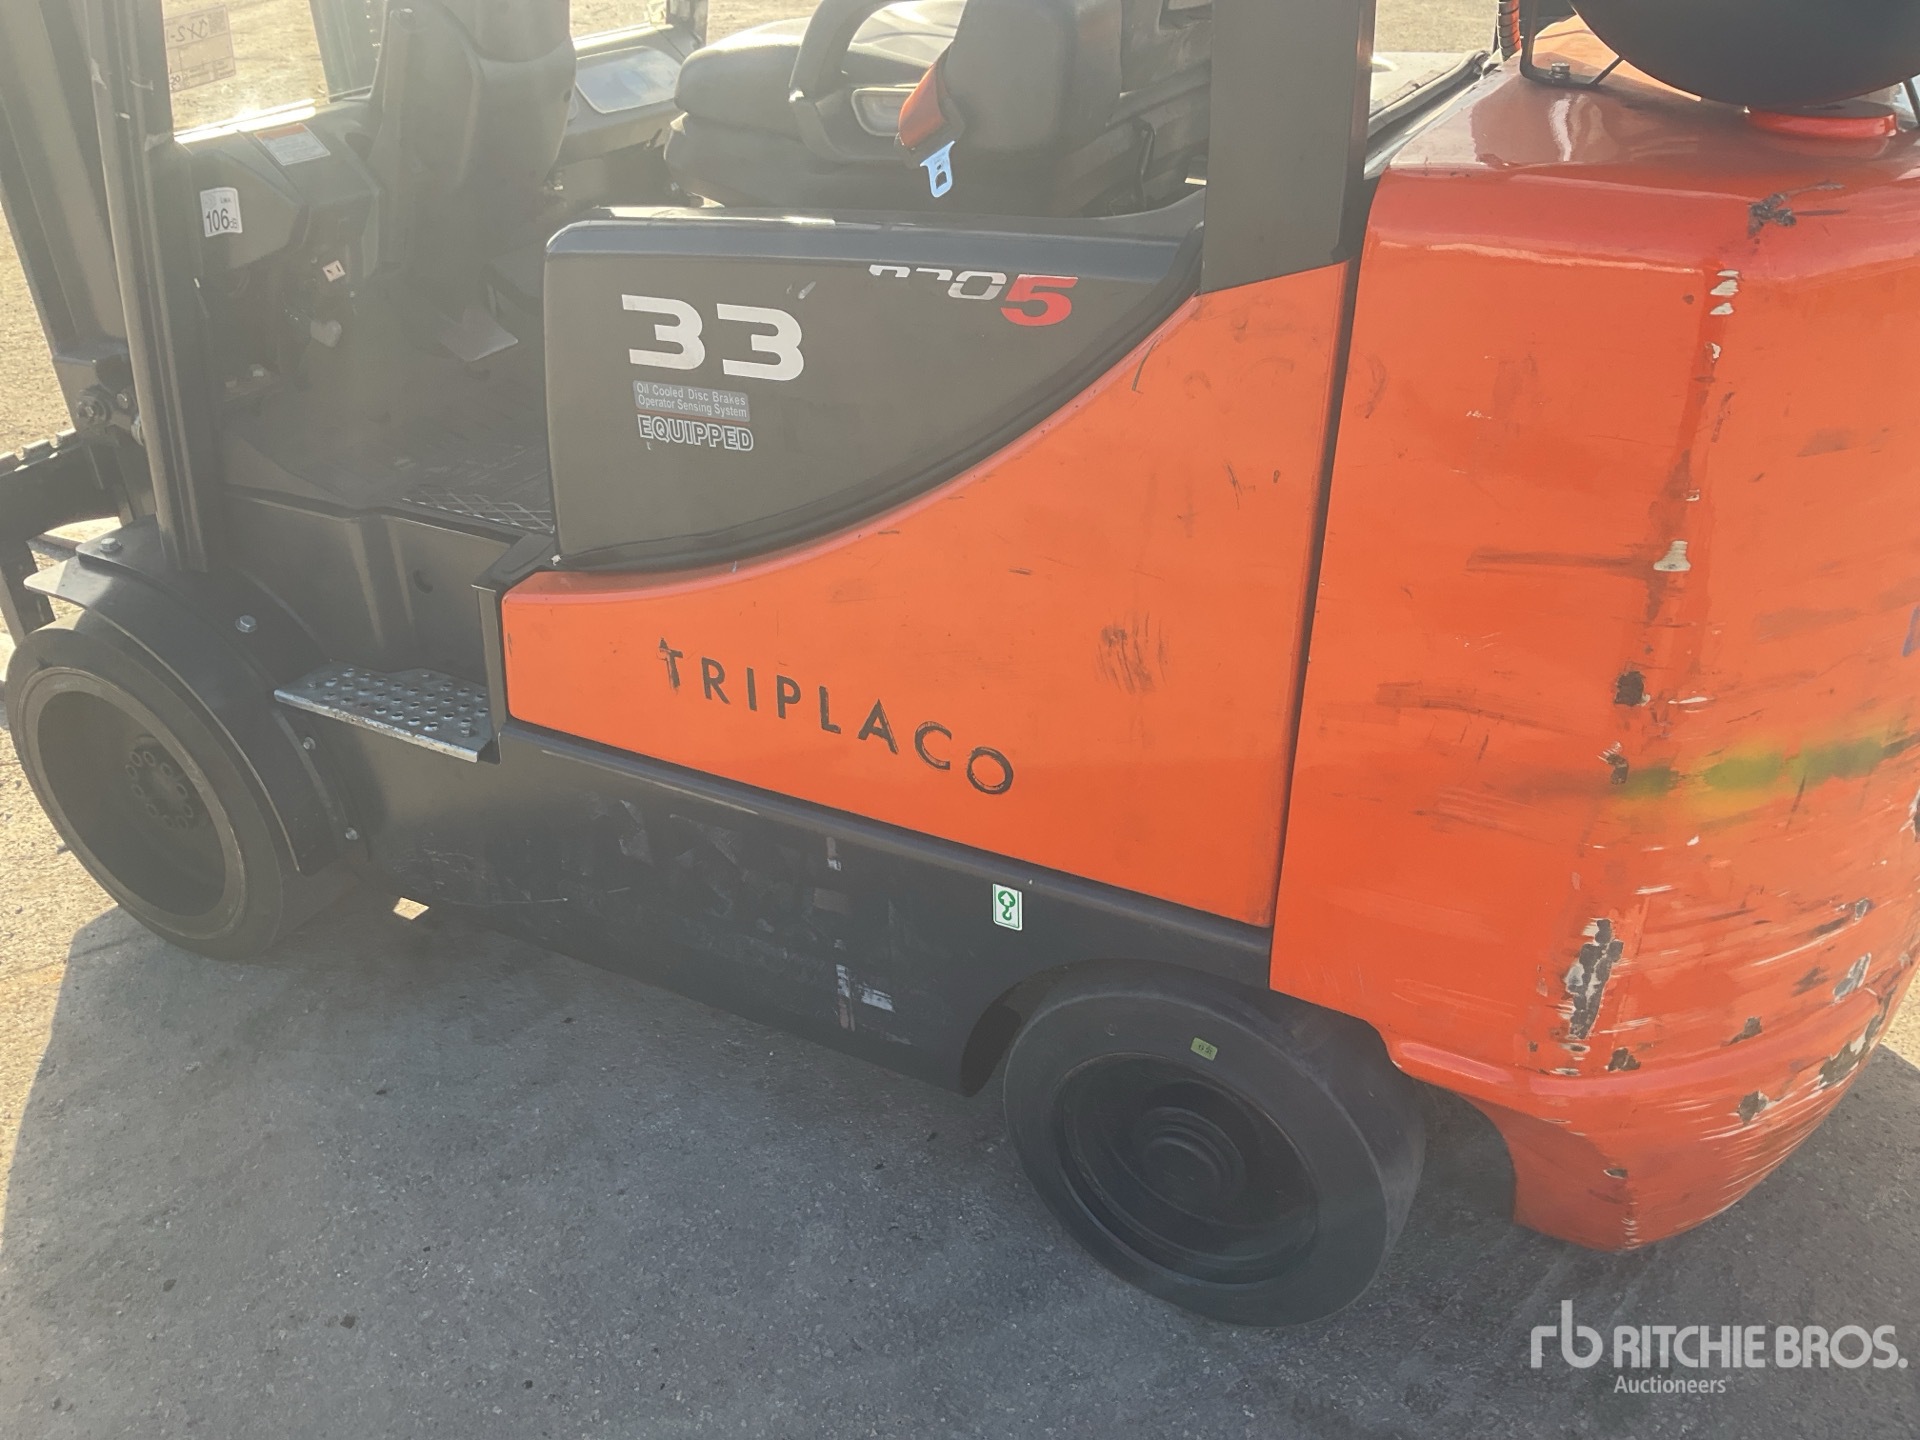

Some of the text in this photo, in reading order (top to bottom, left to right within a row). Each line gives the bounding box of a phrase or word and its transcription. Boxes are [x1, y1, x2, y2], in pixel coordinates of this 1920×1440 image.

[206, 208, 230, 233] 106
[621, 293, 804, 381] 33
[636, 382, 746, 406] Oil Cooled Disc Brakes
[638, 394, 747, 418] Operator Sensing System
[637, 414, 754, 451] EQUIPPED
[657, 638, 1014, 795] TRIPLACO
